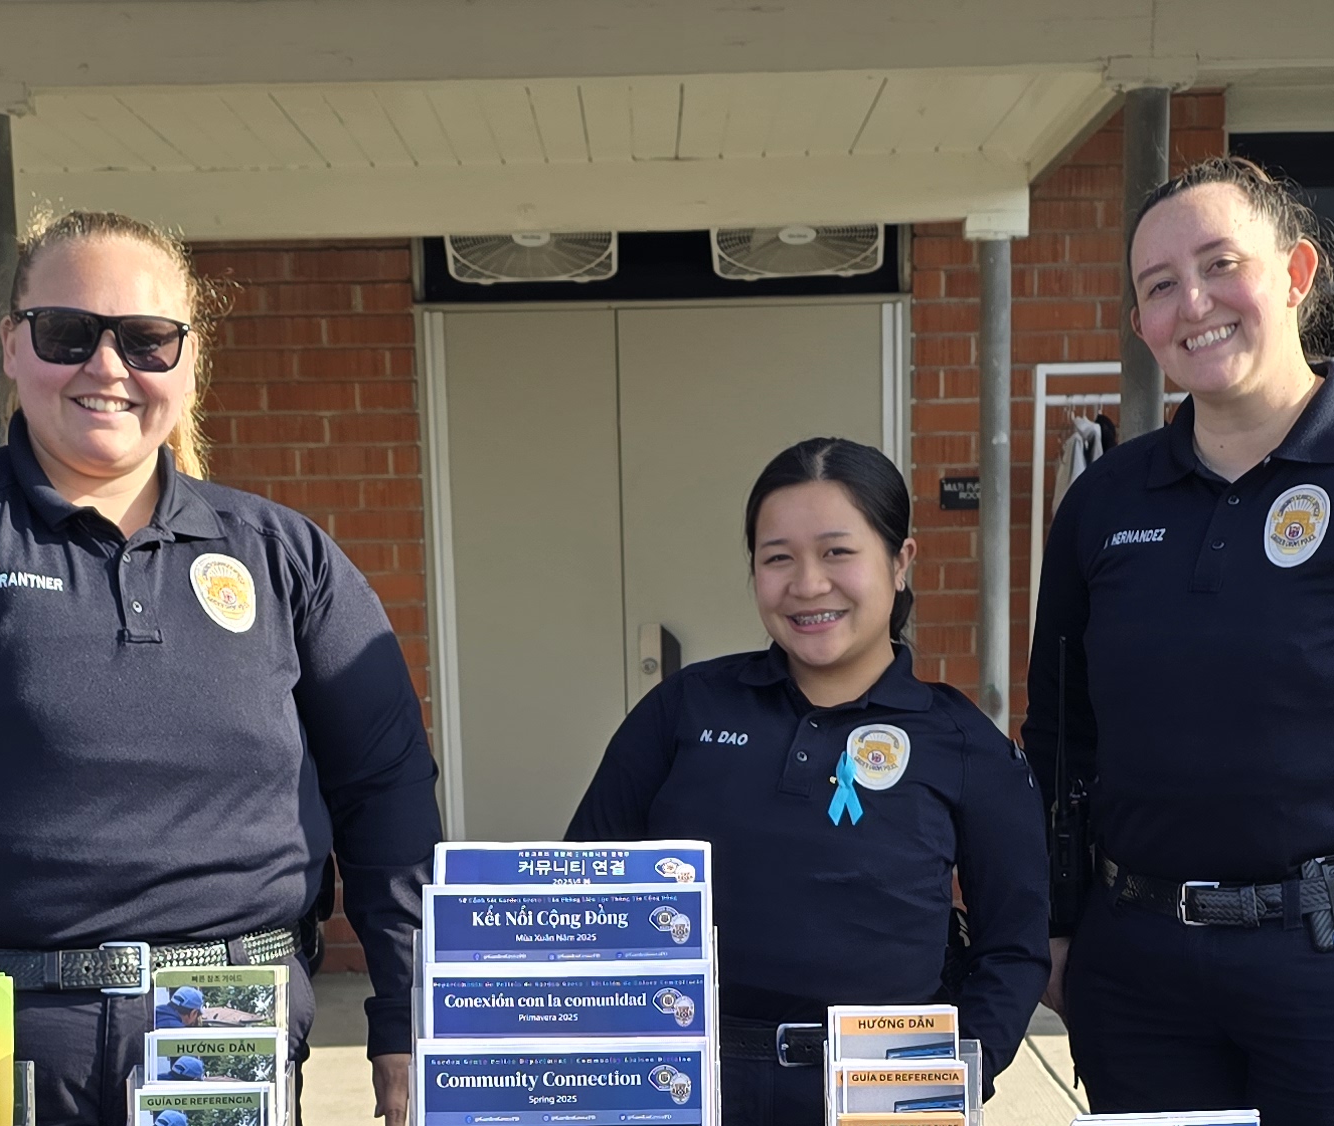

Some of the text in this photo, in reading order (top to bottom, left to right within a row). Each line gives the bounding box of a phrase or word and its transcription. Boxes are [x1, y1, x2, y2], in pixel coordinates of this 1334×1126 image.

[1111, 528, 1165, 545] HERNANDEZ
[700, 729, 748, 746] N. DAO
[518, 859, 625, 876] 커뮤니티 연결
[472, 905, 501, 927] Kết
[536, 910, 581, 929] Cộng
[585, 904, 628, 928] Đồng
[576, 933, 597, 941] 2025
[444, 992, 647, 1008] Conexión con la comunidad
[518, 1013, 578, 1022] Primavera 2025
[858, 1017, 904, 1029] HƯỚNG
[177, 1043, 225, 1054] HƯỚNG
[436, 1071, 642, 1091] Community Connection
[852, 1072, 877, 1082] GUÍA
[895, 1073, 959, 1081] REFERENCIA
[147, 1096, 253, 1106] GUÍA DE REFERENCIA
[529, 1094, 577, 1104] Spring 2025
